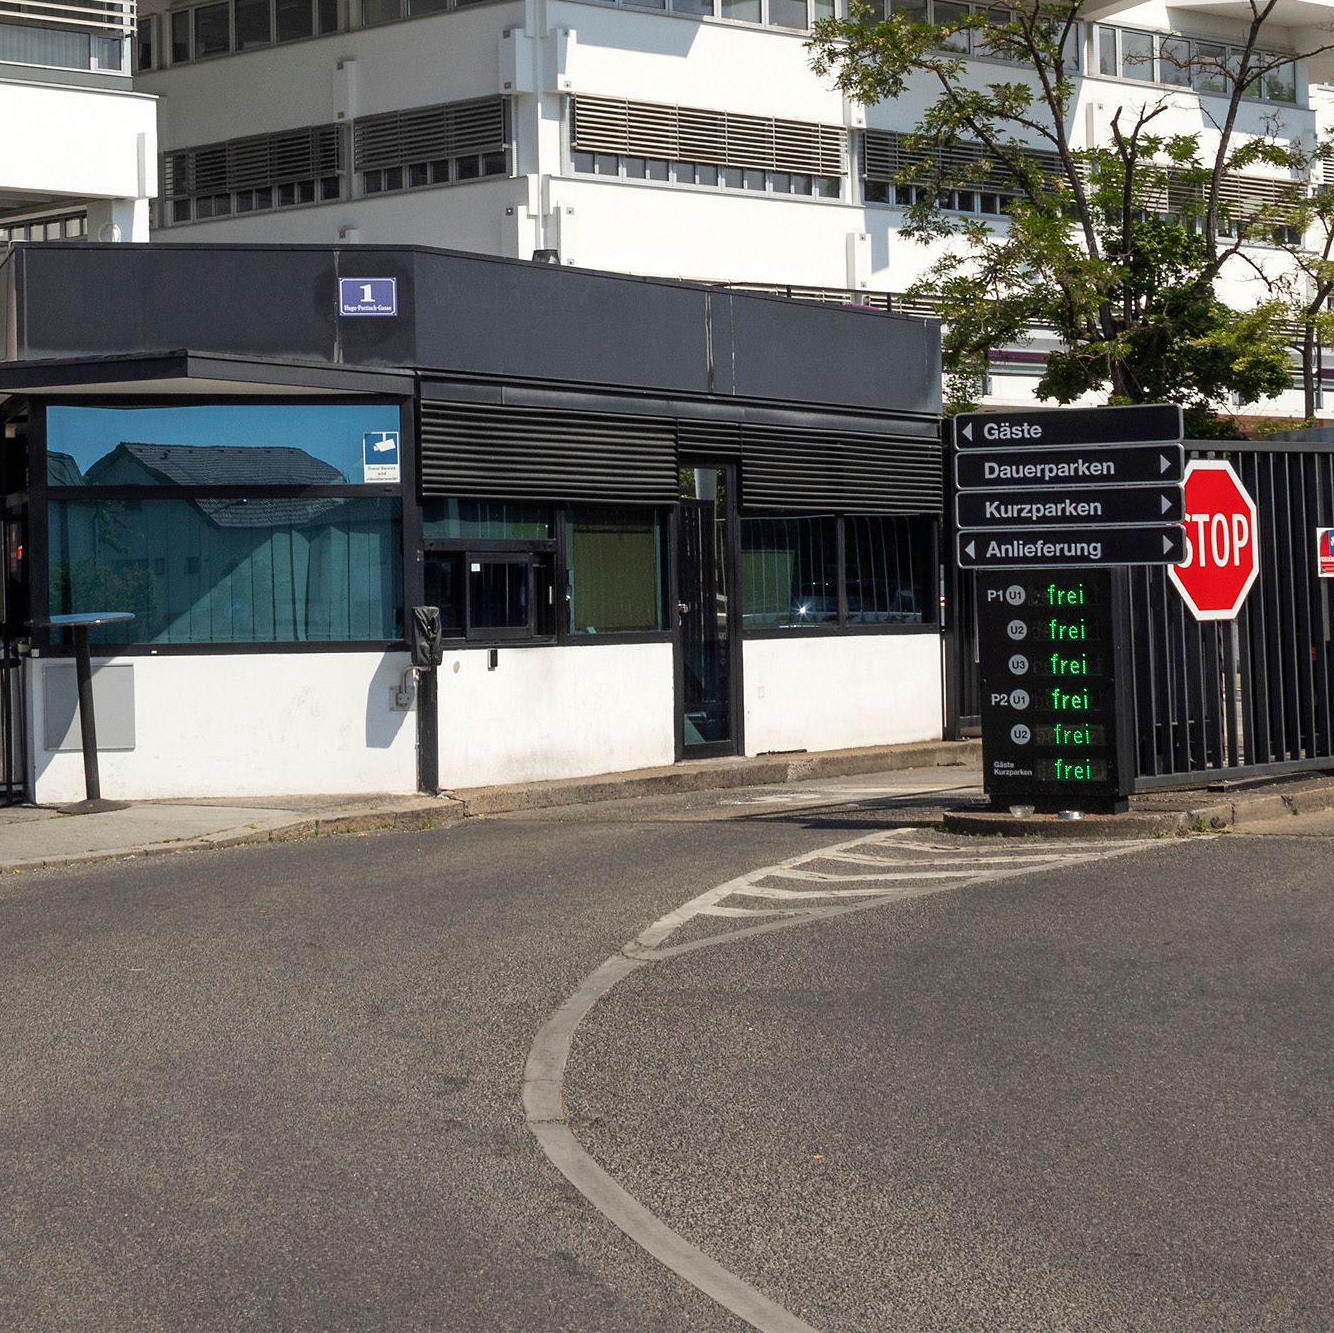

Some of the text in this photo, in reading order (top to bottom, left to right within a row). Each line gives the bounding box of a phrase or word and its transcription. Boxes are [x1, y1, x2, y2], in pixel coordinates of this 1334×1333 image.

[359, 284, 375, 302] 1
[983, 423, 1042, 440] Gäste
[984, 459, 1115, 481] Dauerparken
[985, 500, 1102, 520] Kurzparken
[986, 540, 1102, 559] Anlieferung
[987, 590, 1022, 602] P1 U1
[1047, 584, 1084, 605] frei
[1010, 626, 1024, 634] U2
[1049, 619, 1086, 639] frei
[1012, 661, 1026, 669] U3
[1050, 653, 1087, 674] frei
[991, 694, 1026, 706] P2 U1
[1051, 688, 1089, 709] frei
[1014, 730, 1028, 739] U2
[1053, 723, 1090, 744] frei
[993, 761, 1015, 769] Gäste
[994, 768, 1033, 777] Kurzparken
[1054, 758, 1091, 780] frei
